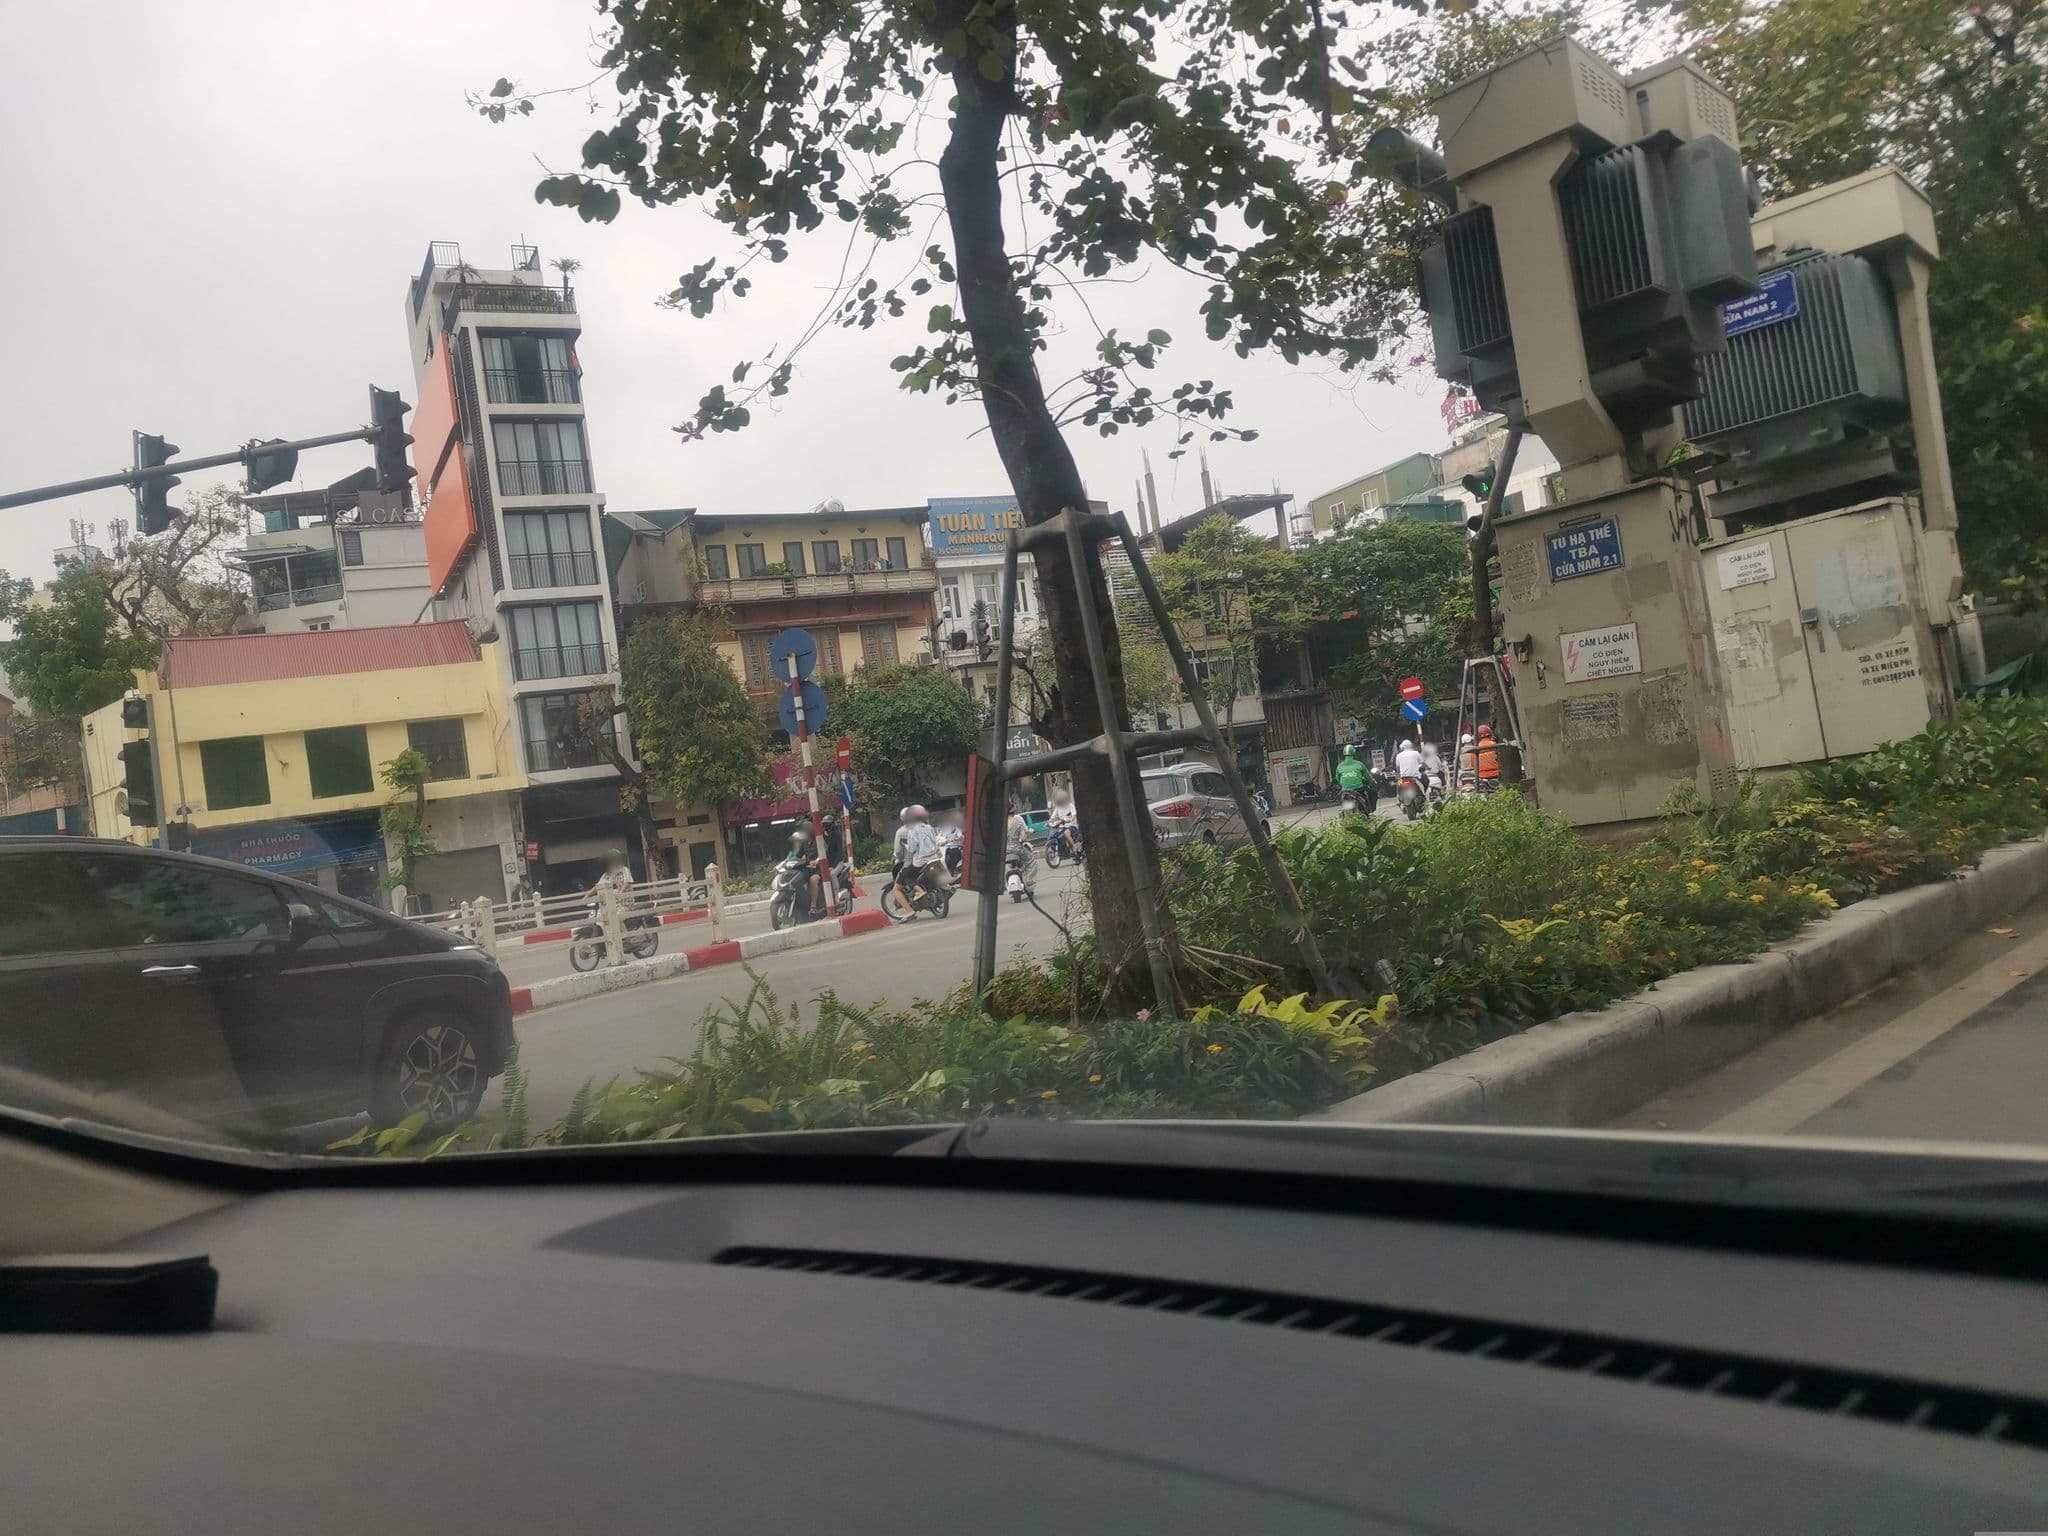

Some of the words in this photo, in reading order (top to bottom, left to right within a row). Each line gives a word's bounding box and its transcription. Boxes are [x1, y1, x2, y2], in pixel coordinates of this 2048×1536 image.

[1743, 303, 1769, 318] NAM
[1770, 300, 1778, 310] 2
[937, 506, 986, 533] TUẤN
[1569, 532, 1586, 546] HẠ
[1568, 544, 1599, 560] TBA
[1577, 556, 1601, 572] NAM
[1602, 553, 1618, 566] 2.1
[1006, 730, 1030, 750] uấn
[244, 850, 303, 866] PHARMACY
